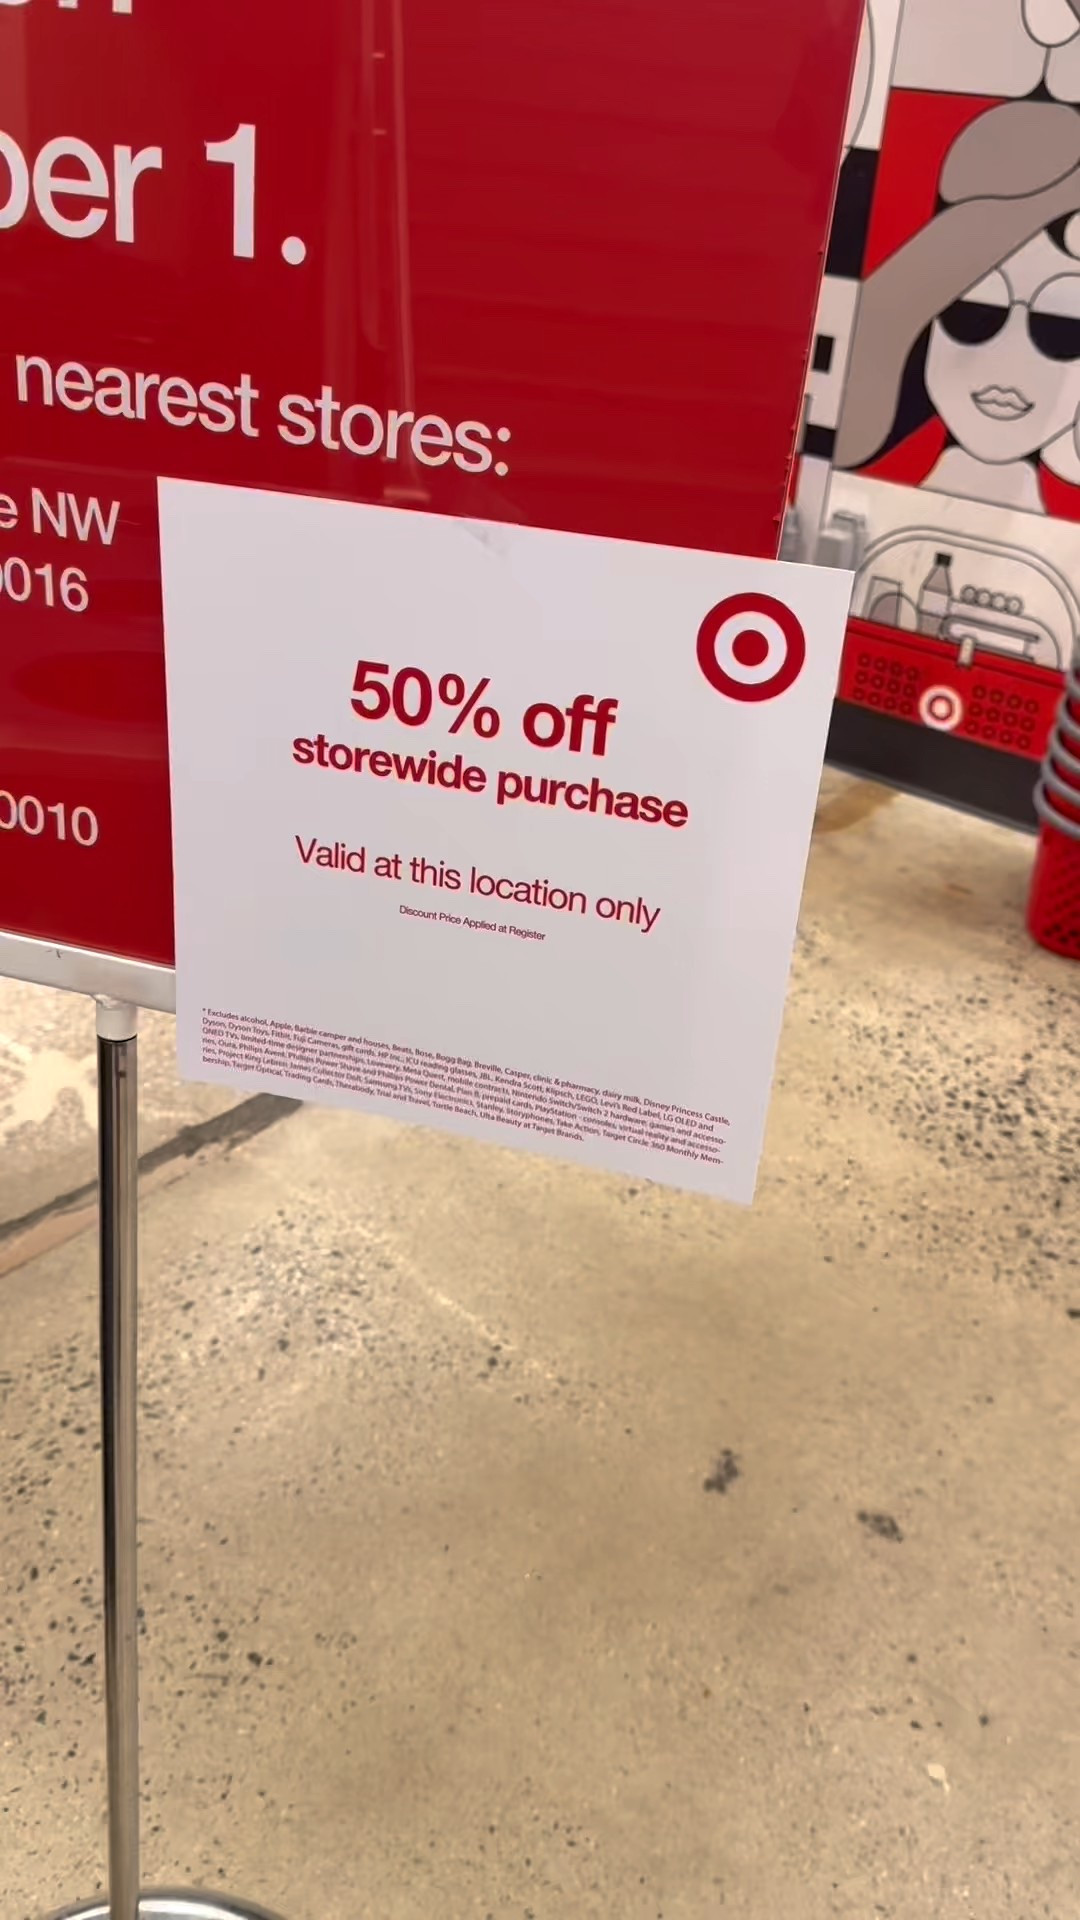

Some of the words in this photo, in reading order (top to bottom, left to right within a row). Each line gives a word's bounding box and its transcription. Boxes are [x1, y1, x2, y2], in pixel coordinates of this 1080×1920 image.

[204, 123, 307, 265] 1.
[15, 354, 260, 437] nearest
[277, 386, 511, 476] stores:
[31, 487, 120, 546] NW
[0, 556, 89, 613] 016
[351, 659, 501, 739] 50%
[522, 693, 619, 757] off
[292, 733, 487, 794] storewide
[496, 770, 689, 828] purchase
[295, 835, 366, 874] Valid
[374, 853, 403, 880] at
[409, 856, 462, 891] this
[470, 866, 587, 914] location
[595, 896, 662, 934] only
[399, 904, 438, 922] Discount
[439, 909, 463, 926] Price
[462, 913, 499, 934] Applied
[498, 923, 508, 934] at
[508, 925, 547, 942] Register
[207, 1009, 239, 1020] Excludes
[319, 1031, 346, 1041] camper
[347, 1036, 362, 1044] and
[436, 1052, 456, 1064] Bogg
[533, 1074, 553, 1083] clinic
[602, 1089, 622, 1101] dairy
[643, 1098, 670, 1112] Disney
[671, 1105, 703, 1119] Princess
[228, 1022, 251, 1032] Dyson
[293, 1034, 306, 1043] Fuji
[341, 1044, 354, 1052] gift
[378, 1051, 388, 1059] HP
[406, 1056, 419, 1065] ICU
[420, 1061, 448, 1073] reading
[495, 1076, 522, 1087] Kendra
[622, 1104, 637, 1113] Red
[663, 1113, 673, 1122] LG
[674, 1116, 697, 1128] OLED
[698, 1123, 714, 1132] and
[233, 1061, 254, 1071] Target
[284, 1070, 311, 1083] Trading
[433, 1101, 453, 1111] Turtle
[479, 1111, 494, 1120] Ulta
[496, 1115, 521, 1128] Beauty
[532, 1123, 555, 1134] Target
[556, 1128, 584, 1141] Brands.
[240, 1033, 285, 1047] limited-time
[286, 1041, 317, 1053] designer
[403, 1065, 421, 1075] Meta
[447, 1076, 473, 1086] mobile
[512, 1088, 547, 1102] Nintendo
[549, 1096, 602, 1115] Switch/Switch
[649, 1121, 675, 1132] games
[676, 1128, 692, 1136] and
[693, 1132, 726, 1144] accesso-
